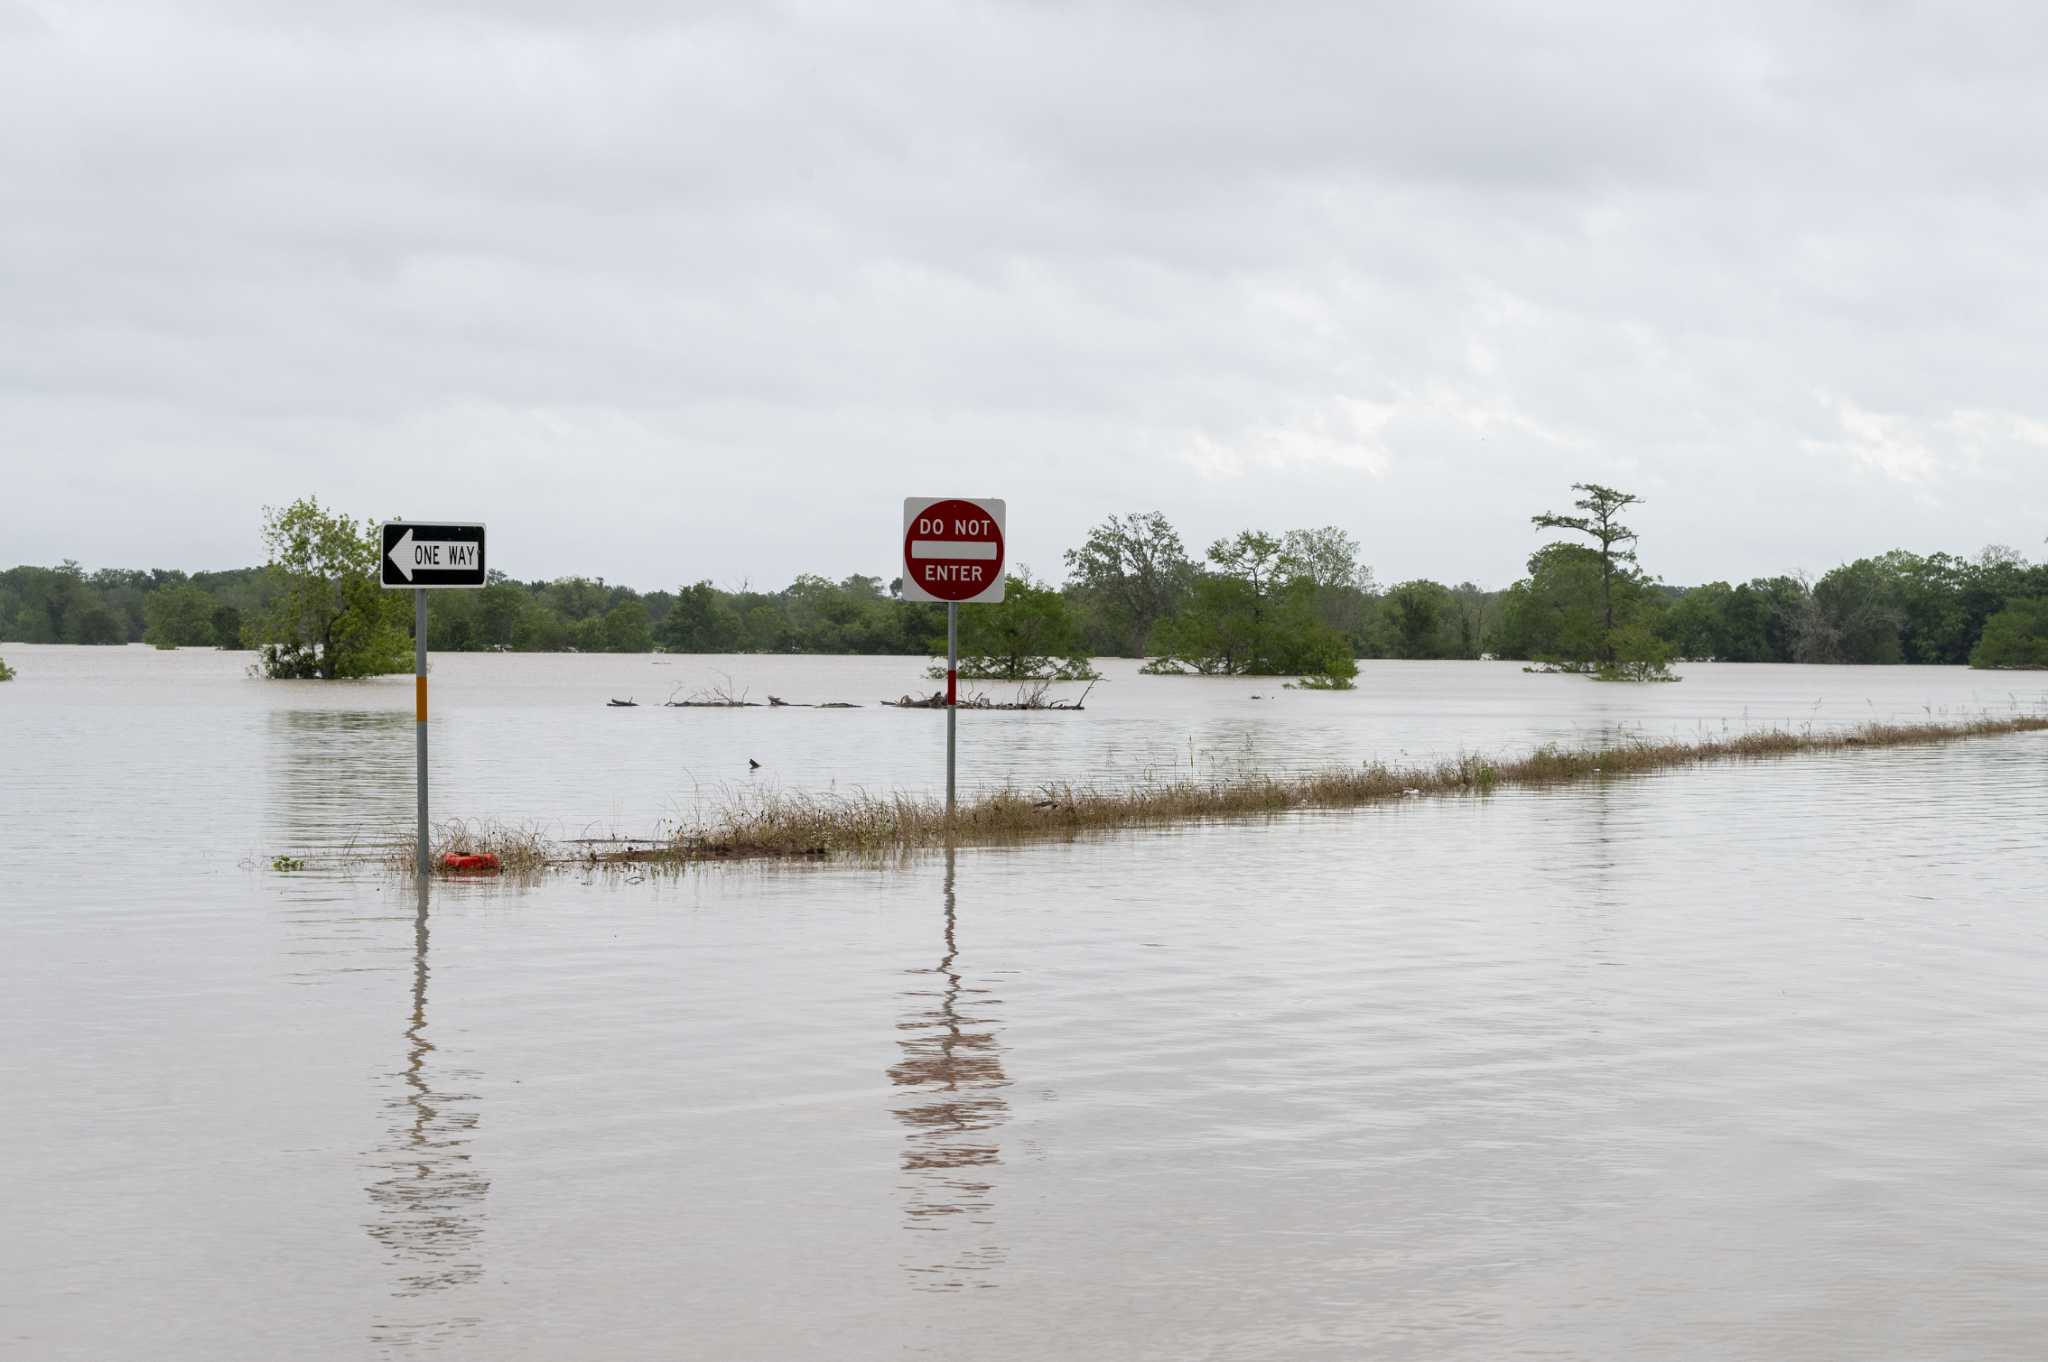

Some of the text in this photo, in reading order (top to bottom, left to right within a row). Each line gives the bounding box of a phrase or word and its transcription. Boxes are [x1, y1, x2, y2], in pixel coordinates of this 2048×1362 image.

[920, 519, 991, 536] DO NOT
[415, 545, 475, 566] ONE WAY
[925, 565, 983, 581] ENTER
